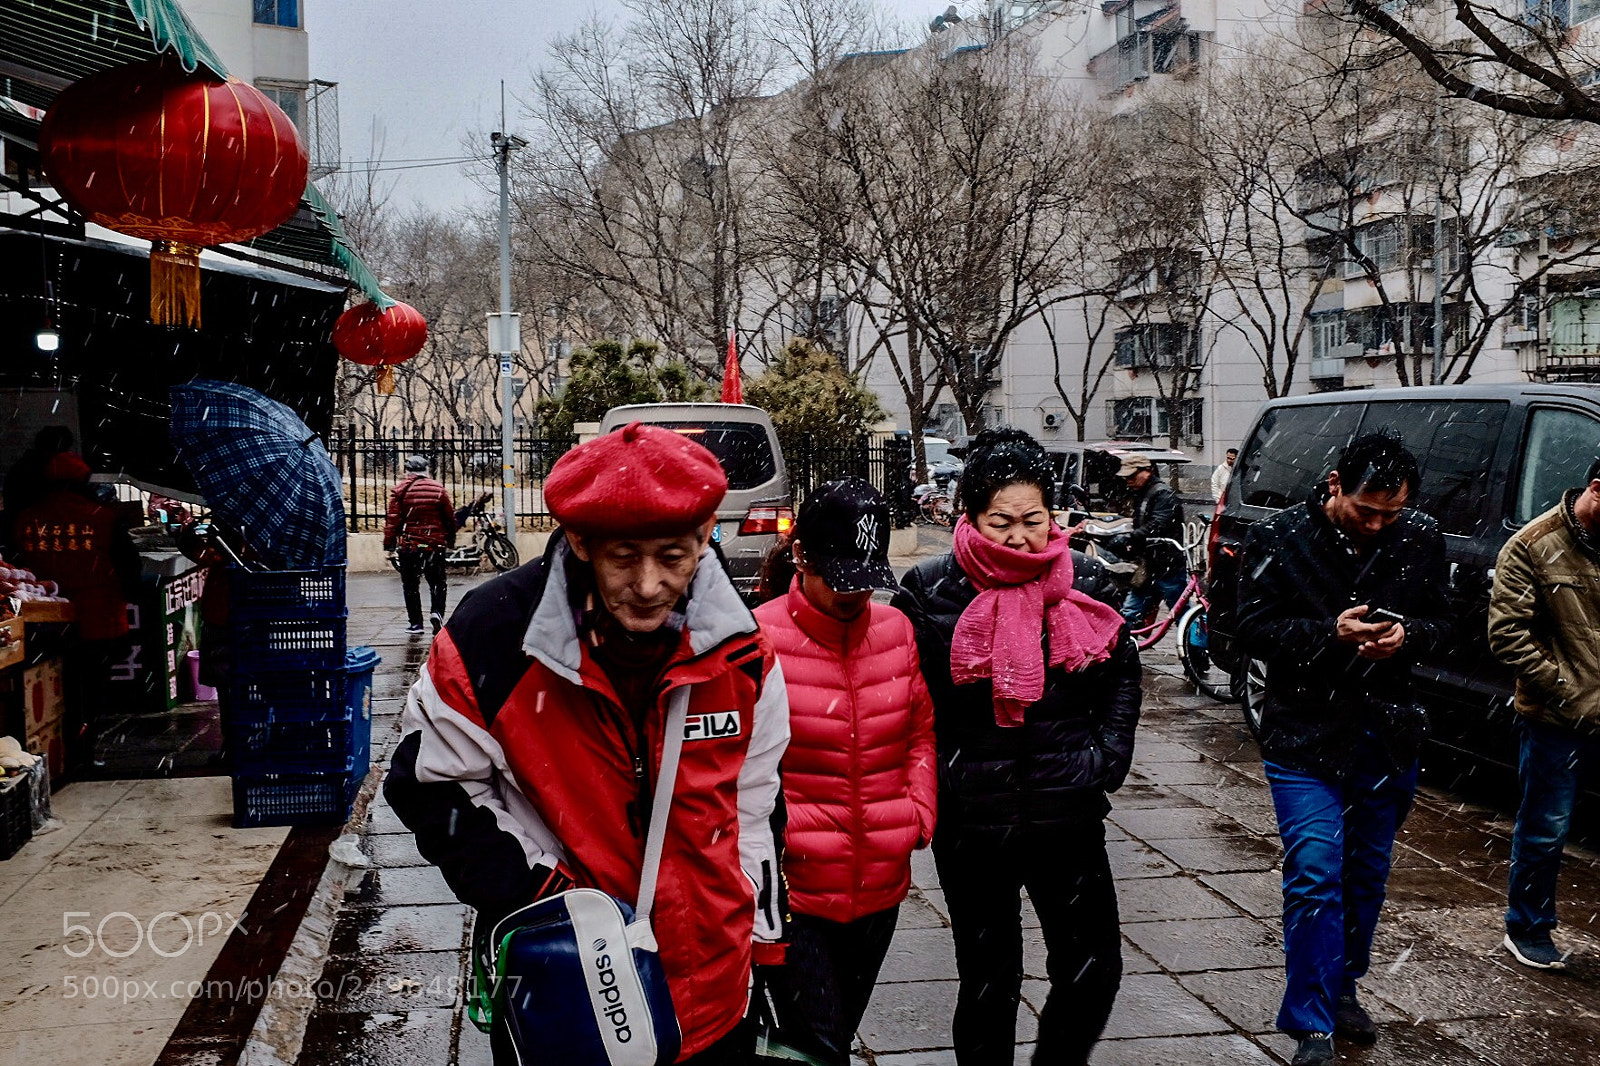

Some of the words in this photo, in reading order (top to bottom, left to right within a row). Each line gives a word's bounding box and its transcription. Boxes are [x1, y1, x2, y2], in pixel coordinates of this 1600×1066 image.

[856, 514, 878, 550] NY
[684, 713, 738, 738] FILA
[595, 954, 632, 1044] adidas
